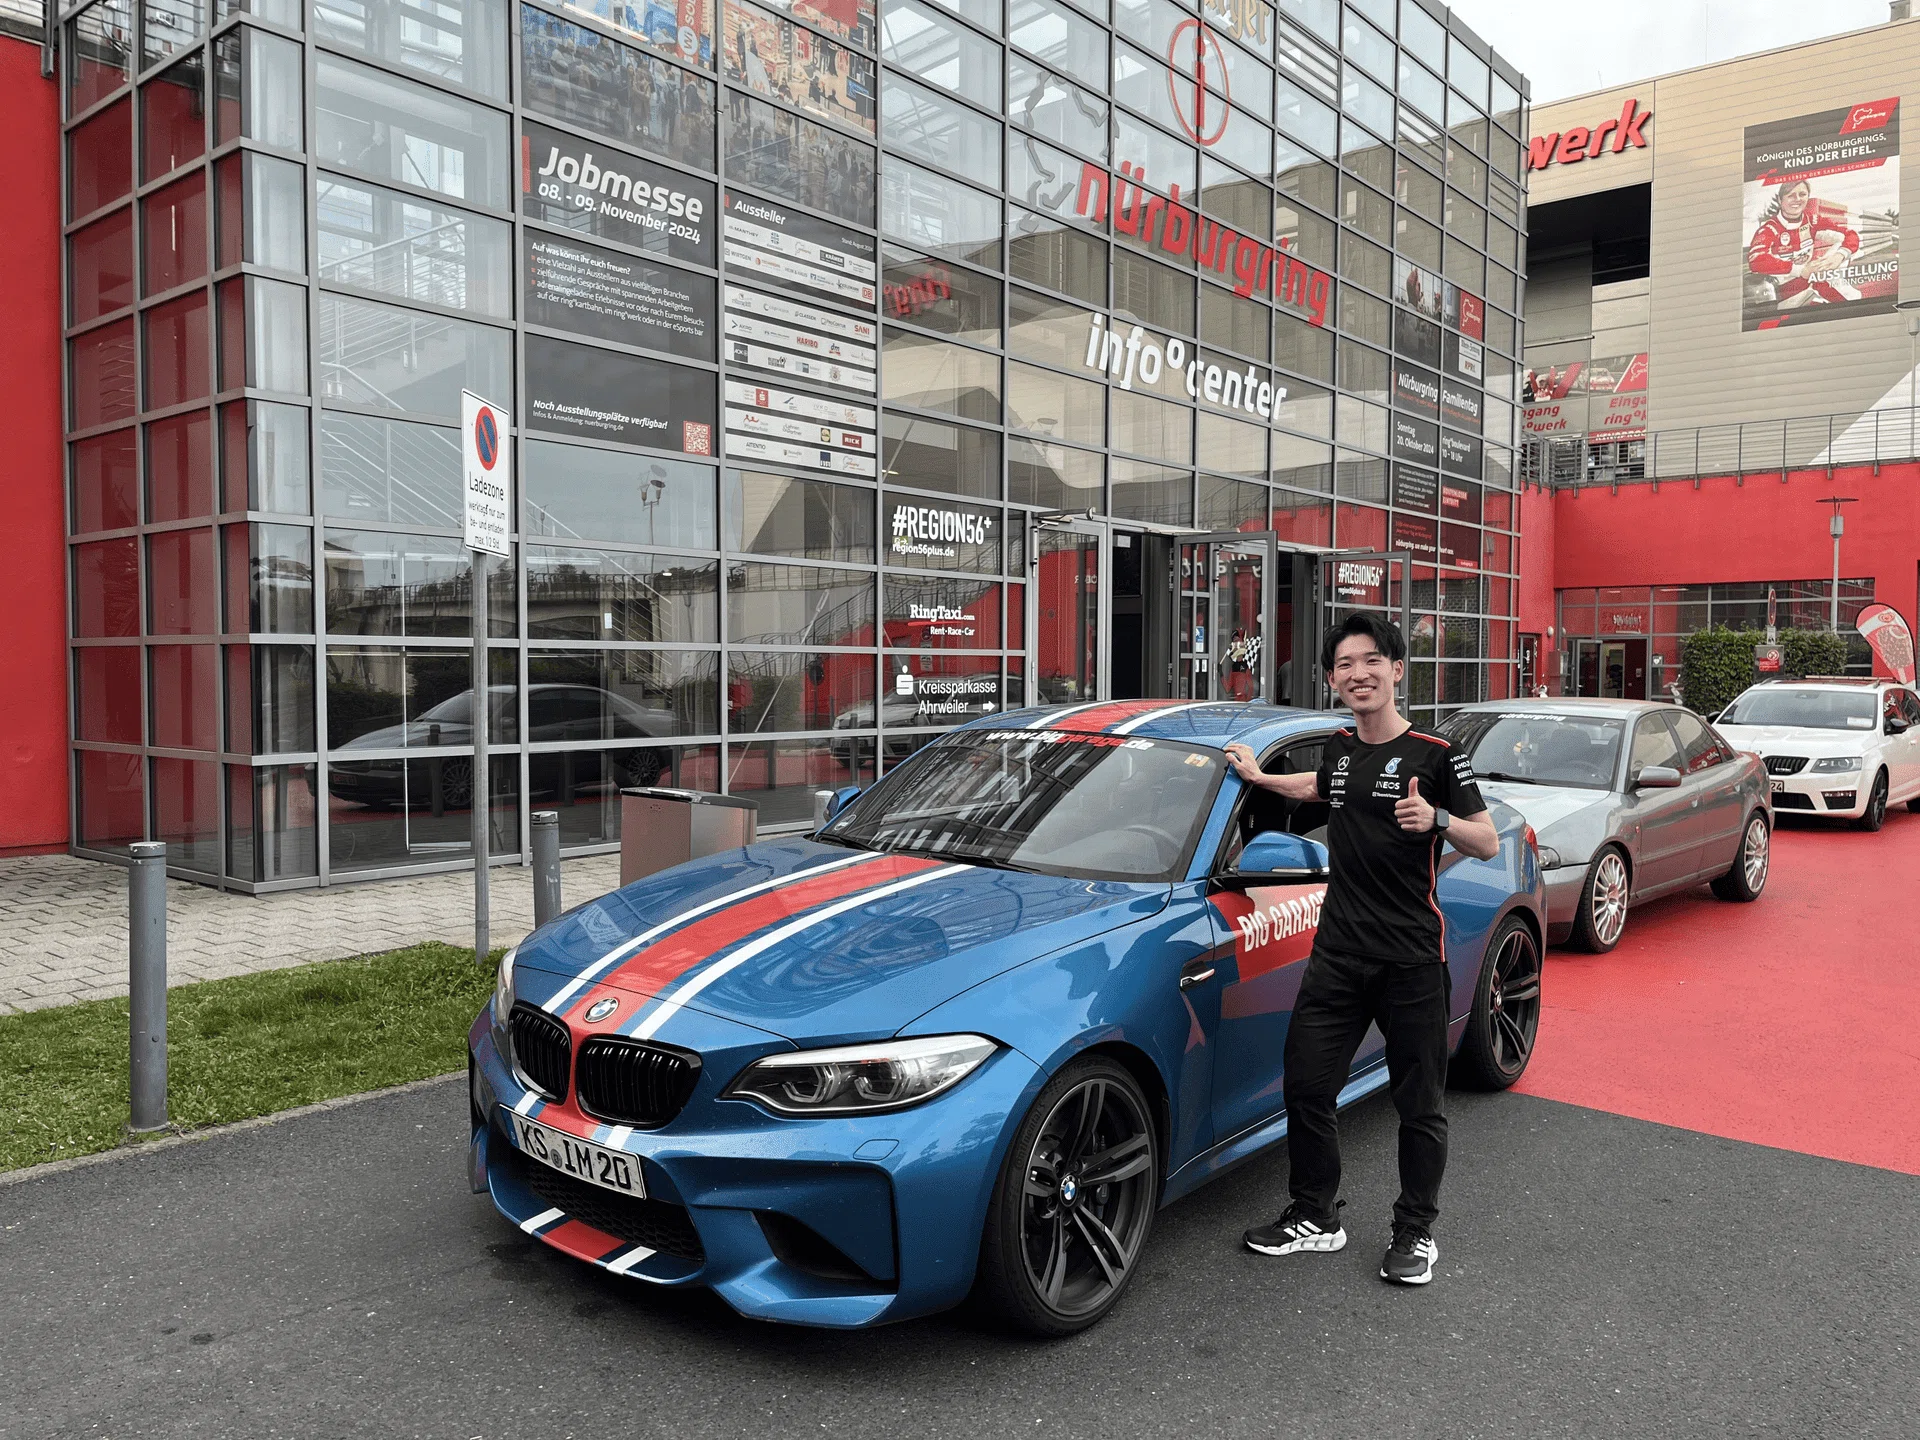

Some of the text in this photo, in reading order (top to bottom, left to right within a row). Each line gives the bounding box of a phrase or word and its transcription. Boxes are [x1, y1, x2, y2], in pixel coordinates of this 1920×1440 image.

[1757, 133, 1887, 163] KÖNIGIN DES NÜRBURGRINGS.
[1784, 145, 1876, 169] KIND DER EIFEL.
[1788, 173, 1807, 181] LEBEN
[1823, 167, 1846, 175] SABINE
[1847, 162, 1876, 171] SCHMITZ
[538, 147, 703, 223] Jobmesse
[538, 183, 562, 201] 08.
[575, 194, 597, 212] 09.
[600, 201, 668, 232] November
[668, 222, 701, 245] 2024
[734, 200, 786, 225] Aussteller
[734, 226, 758, 237] MANTHEY
[1076, 160, 1330, 328] nürburgring
[532, 242, 631, 275] Auf was könnt ihr euch freuen?
[537, 256, 551, 266] eine
[552, 259, 577, 272] Vielzahl
[577, 267, 586, 275] an
[586, 268, 620, 283] Ausstellern
[620, 278, 631, 286] aus
[663, 287, 690, 301] Branchen
[1807, 260, 1898, 284] AUSSTELLUNG
[537, 268, 694, 313] zielführende Gespräche mit spannenden Arbeitgebern
[537, 280, 594, 300] adrenalingeladene
[595, 293, 625, 308] Erlebnisse
[636, 304, 650, 313] oder
[650, 308, 664, 317] nach
[665, 310, 682, 321] Eurem
[537, 291, 548, 300] auf
[548, 292, 559, 302] der
[605, 307, 613, 315] im
[642, 316, 655, 325] oder
[663, 320, 672, 329] der
[673, 323, 694, 335] eSports
[694, 328, 704, 336] bar
[796, 336, 819, 348] HARIBO
[1398, 373, 1438, 402] Nürburgring
[1442, 389, 1478, 417] Familientag
[533, 400, 668, 430] Noch Ausstellungsplätze verfügbar!
[533, 410, 546, 419] Infos
[584, 419, 624, 431] nuerburgring.de
[844, 437, 860, 445] RICK
[1397, 421, 1416, 438] Sonntag
[1405, 437, 1423, 451] Oktober
[469, 471, 504, 501] Ladezone
[497, 510, 505, 520] zum
[479, 520, 487, 530] und
[488, 523, 505, 535] entladen
[892, 542, 955, 557] region56plus.de
[910, 603, 975, 622] RingTaxi.com
[918, 679, 997, 697] Kreissparkasse
[918, 700, 969, 716] Ahrweiler
[1498, 713, 1567, 722] nürburgring
[986, 730, 1155, 750] www.biggarage.de
[1375, 780, 1400, 790] INEOS
[1236, 910, 1269, 953] BIG
[519, 1119, 632, 1190] KS IM 20
